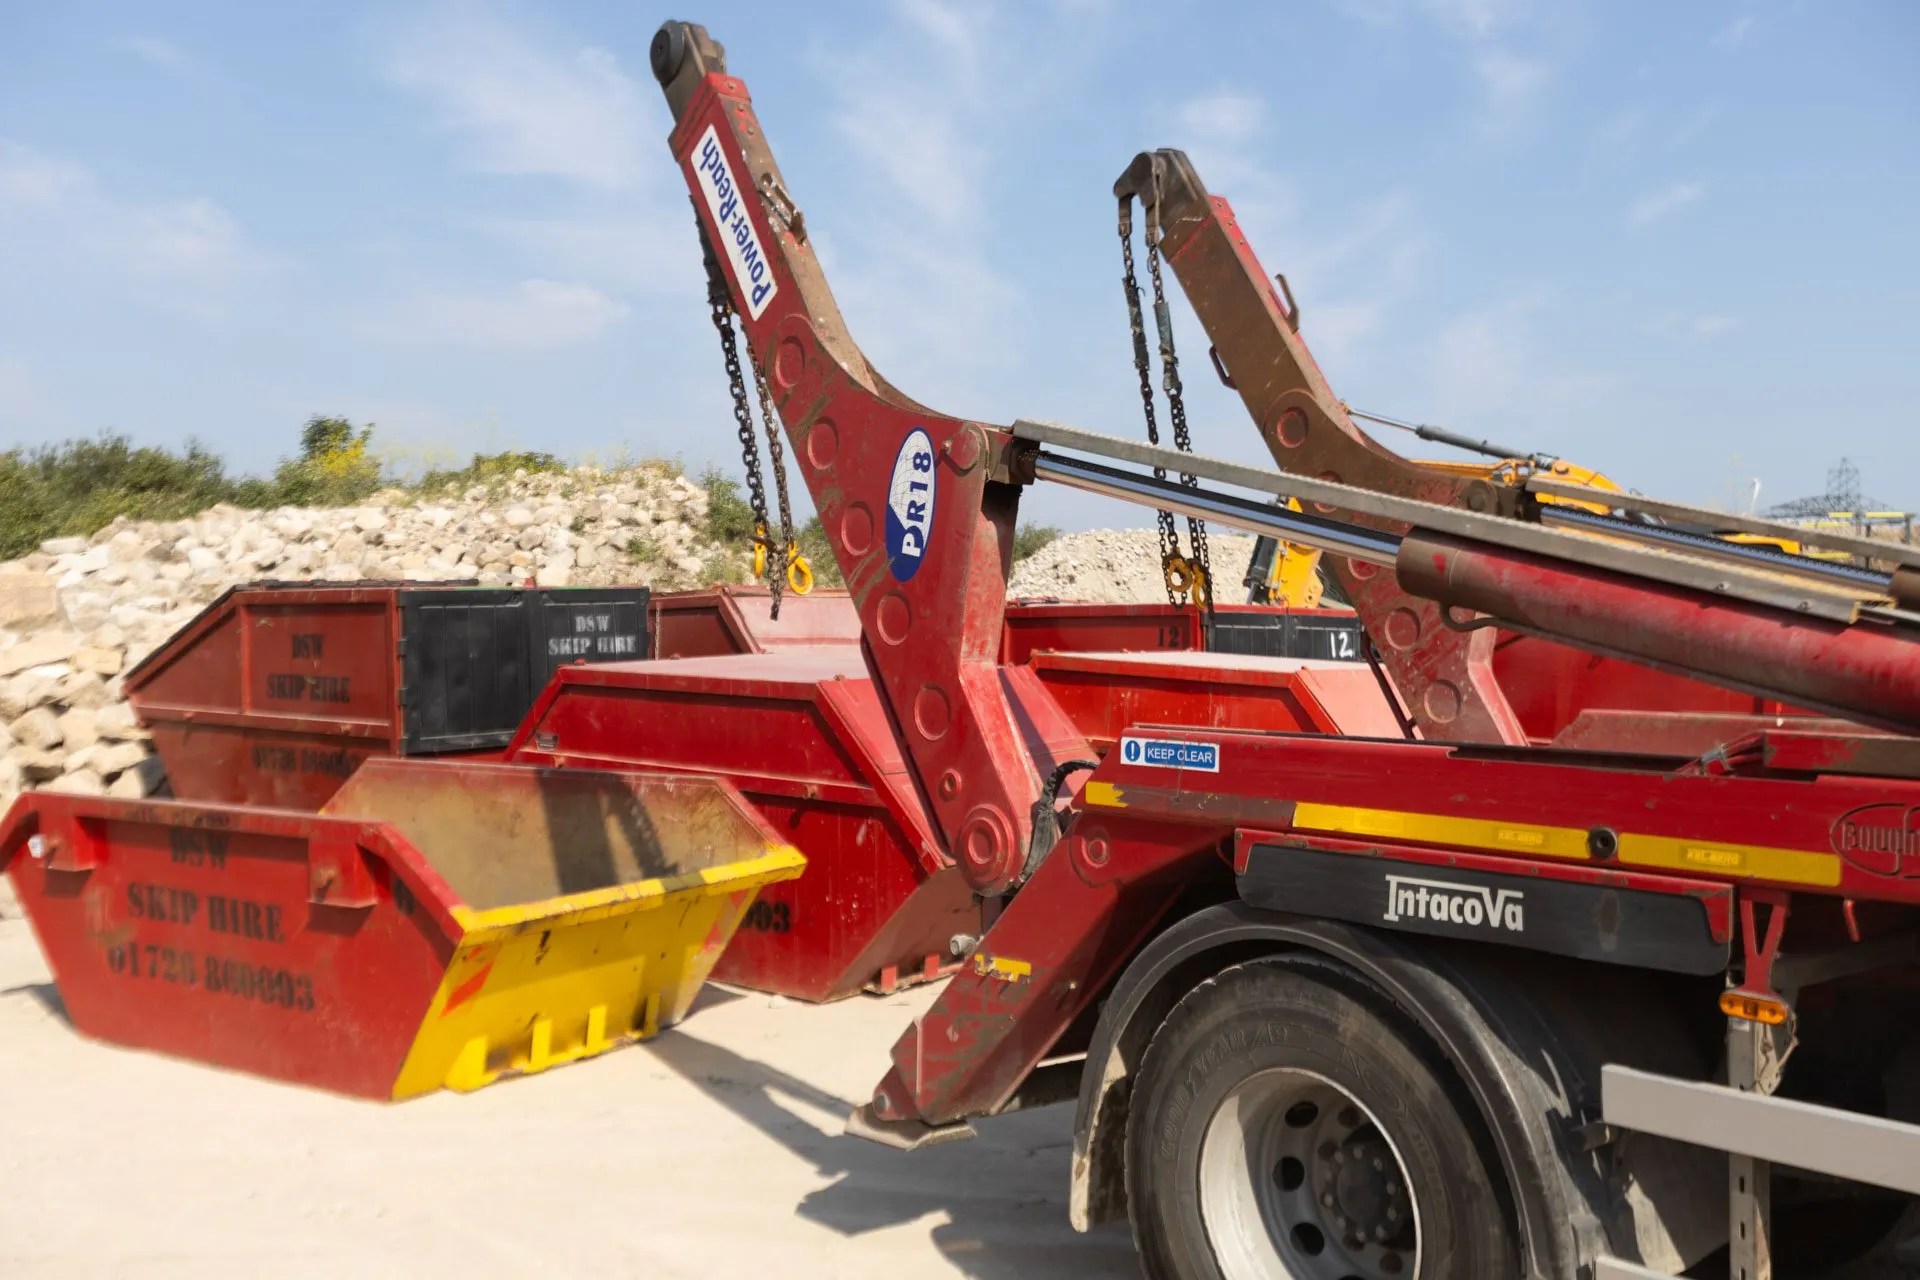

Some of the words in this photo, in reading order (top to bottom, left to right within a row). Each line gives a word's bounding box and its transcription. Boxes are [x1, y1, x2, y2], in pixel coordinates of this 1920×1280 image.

[700, 137, 771, 307] Power-Reach
[902, 452, 932, 557] PR18
[574, 615, 609, 632] DSW
[1158, 627, 1180, 647] 12
[548, 637, 591, 655] SKIP
[597, 636, 636, 654] HIRE
[1330, 632, 1354, 657] 12
[267, 674, 306, 699] SKIP
[310, 676, 351, 703] HIRE
[1147, 748, 1174, 760] KEEP
[1177, 750, 1213, 764] CLEAR
[127, 882, 198, 925] SKIP
[206, 896, 285, 943] HIRE
[1383, 874, 1524, 931] IntacoVa
